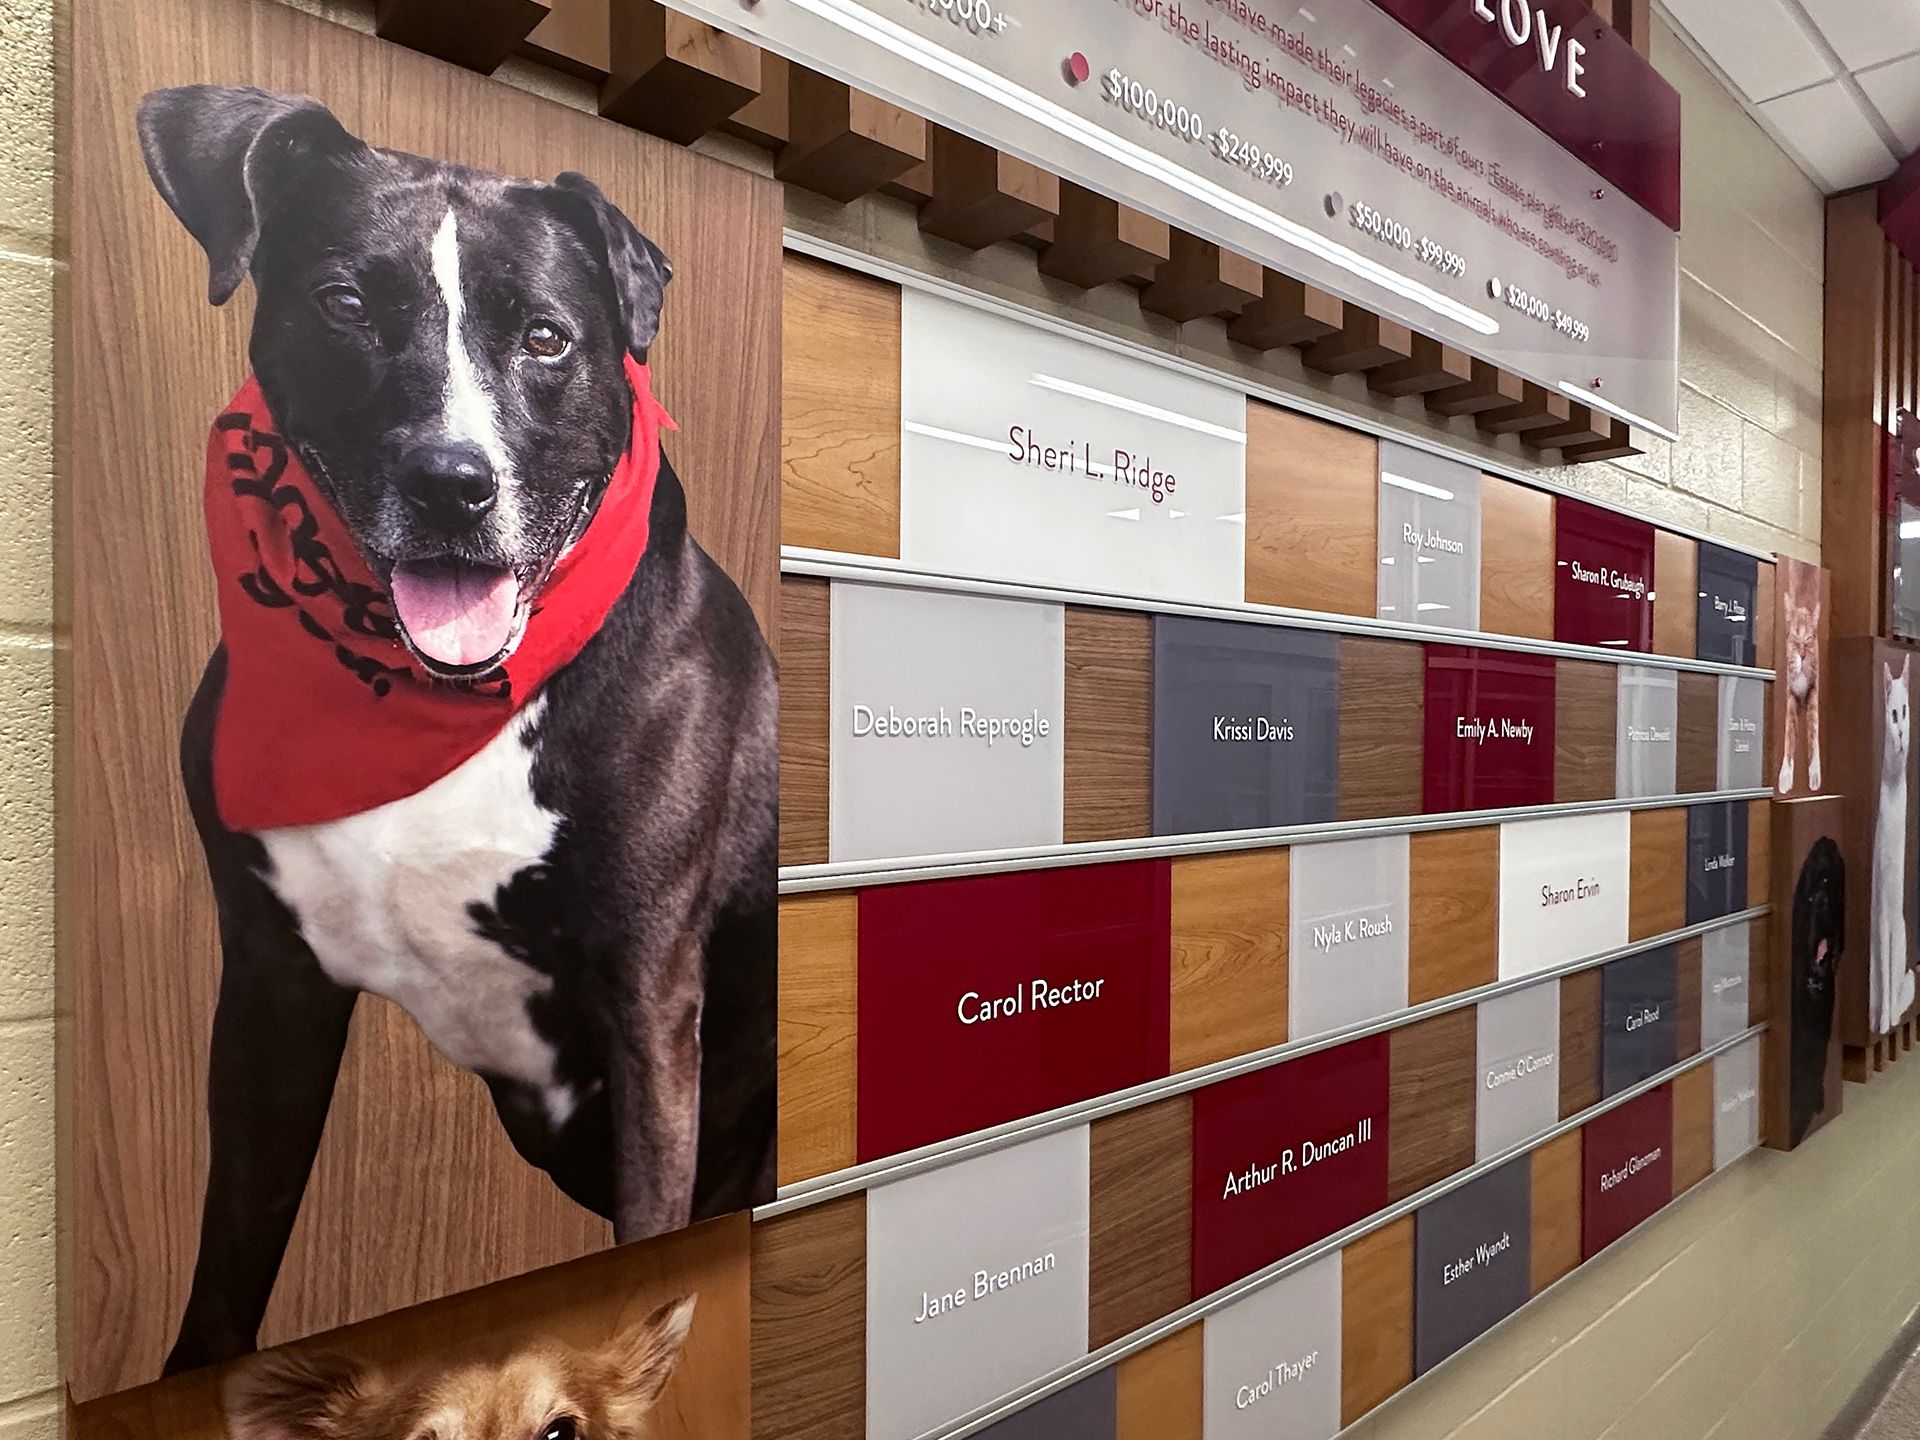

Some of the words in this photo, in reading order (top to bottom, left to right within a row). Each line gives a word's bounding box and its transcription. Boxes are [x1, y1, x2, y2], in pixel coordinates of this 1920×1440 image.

[1135, 0, 1163, 17] or
[1168, 3, 1199, 41] the
[1205, 20, 1260, 89] lasting
[1265, 58, 1319, 114] impact
[1323, 97, 1356, 143] they
[1359, 124, 1380, 152] will
[1384, 132, 1413, 172] have
[1416, 163, 1432, 182] on
[1434, 167, 1455, 196] the
[1457, 187, 1496, 221] animals
[1271, 23, 1313, 63] made
[1318, 47, 1352, 86] their
[1354, 68, 1407, 124] legacies
[1419, 121, 1444, 150] part
[1109, 67, 1203, 140] $100,000
[1218, 126, 1294, 186] $249,999
[1356, 200, 1411, 249] $50,000
[1421, 235, 1466, 277] $99,999
[1507, 283, 1550, 322] $20,000
[1555, 308, 1590, 343] $49,999
[1009, 425, 1075, 472] Sheri
[1085, 443, 1104, 479] L.
[1114, 449, 1176, 503] Ridge
[1403, 522, 1424, 552] Roy
[1424, 528, 1464, 554] Johnson
[1572, 560, 1600, 585] Sharon
[1610, 569, 1645, 600] Grubaugh
[852, 703, 952, 737] Deborah
[959, 706, 1050, 747] Reprogle
[1213, 716, 1252, 741] Krissi
[1256, 716, 1294, 741] Davis
[1456, 716, 1486, 746] Emily
[1486, 717, 1499, 738] A.
[1501, 717, 1533, 745] Newby
[1541, 885, 1575, 907] Sharon
[1577, 877, 1600, 900] Ervin
[1314, 923, 1341, 953] Nyla
[1344, 920, 1356, 941] K.
[1359, 914, 1392, 939] Roush
[957, 983, 1023, 1025] Carol
[1031, 979, 1104, 1011] Rector
[1626, 1010, 1643, 1031] Carol
[1222, 1162, 1278, 1200] Arthur
[1281, 1149, 1298, 1176] R.
[1302, 1132, 1355, 1168] Duncan
[1358, 1117, 1372, 1144] III
[1600, 1160, 1628, 1193] Richard
[1443, 1257, 1475, 1286] Esther
[1475, 1231, 1510, 1267] Wyandt
[914, 1291, 967, 1323] Jane
[973, 1252, 1056, 1301] Brennan
[1236, 1369, 1273, 1409] Carol
[1275, 1350, 1319, 1386] Thayer
